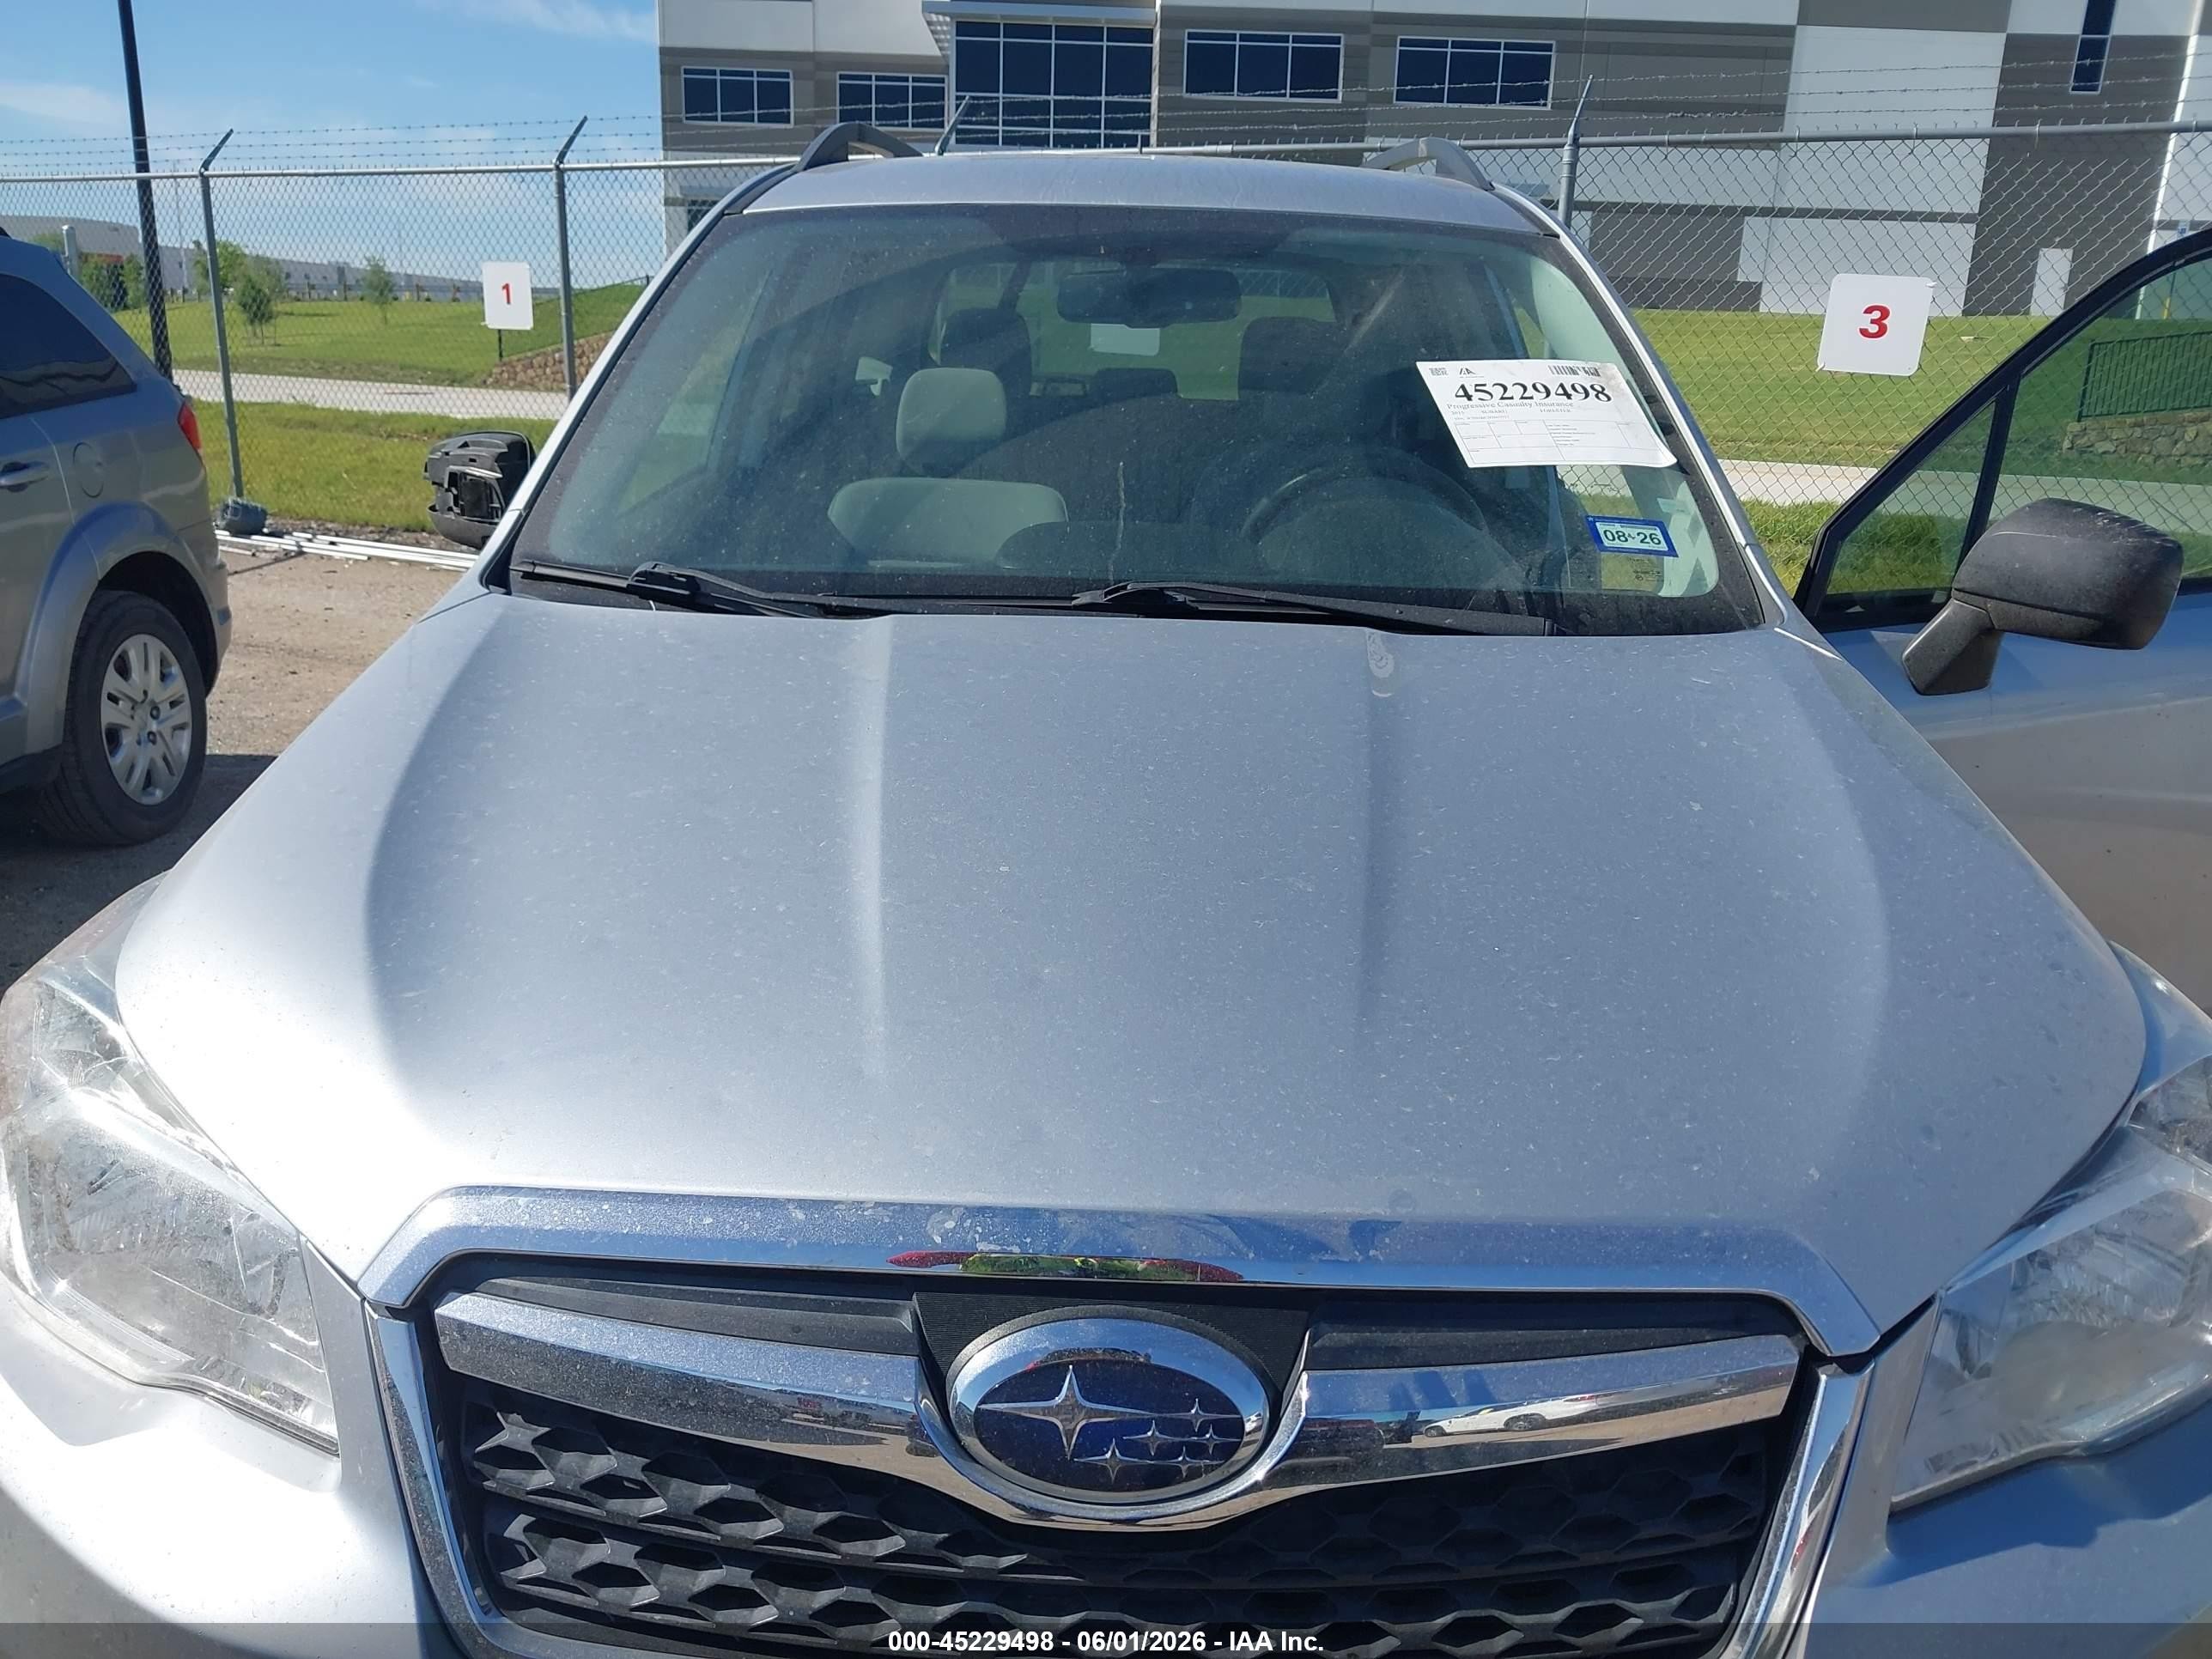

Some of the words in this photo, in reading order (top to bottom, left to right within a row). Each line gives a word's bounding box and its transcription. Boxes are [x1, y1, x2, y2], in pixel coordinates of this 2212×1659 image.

[501, 283, 511, 305] 1
[1858, 305, 1891, 339] 3
[1455, 382, 1613, 403] 45229498
[1447, 402, 1496, 410] Progressive
[1602, 529, 1629, 543] 08
[1637, 532, 1662, 545] 26
